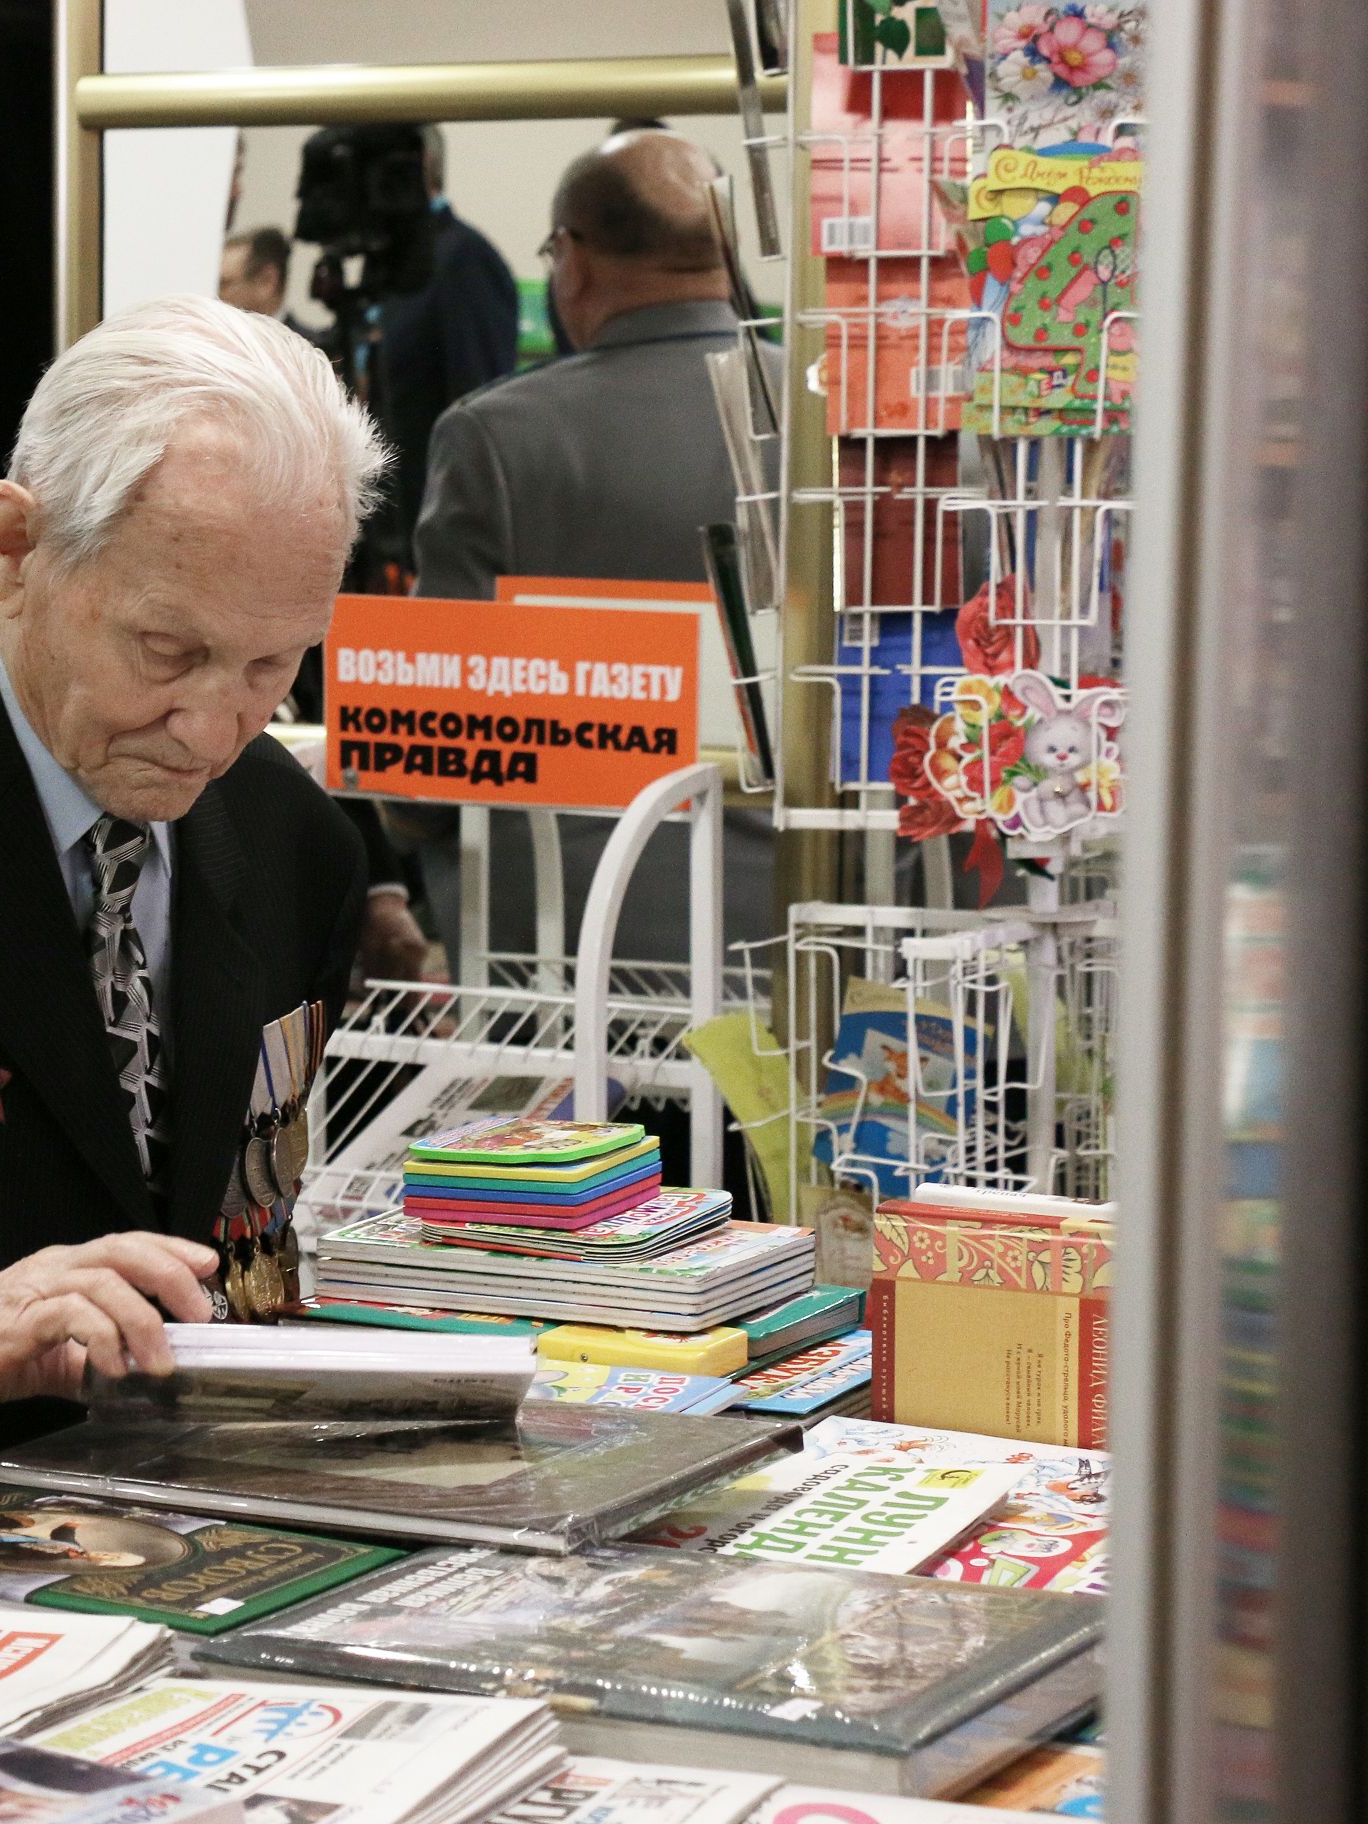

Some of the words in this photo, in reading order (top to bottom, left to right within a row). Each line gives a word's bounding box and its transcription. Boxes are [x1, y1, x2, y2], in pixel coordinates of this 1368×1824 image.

[337, 647, 461, 689] ВОЗЬМИ
[467, 655, 569, 696] ЗДЕСЬ
[574, 661, 683, 702] ГАЗЕТУ
[339, 705, 678, 755] КОМСОМОЛЬСКАЯ
[339, 740, 538, 786] ПРАВДА
[1062, 1312, 1072, 1328] Про
[1089, 1313, 1110, 1387] ЛЕОНИД
[1091, 1393, 1110, 1448] ФИЛА
[762, 1464, 849, 1512] садовода
[805, 1490, 950, 1567] ЛУНН
[141, 1543, 303, 1601] СУВОРОВ
[354, 1547, 500, 1603] чественная
[143, 1743, 239, 1783] РЕ
[202, 1749, 288, 1793] СТА
